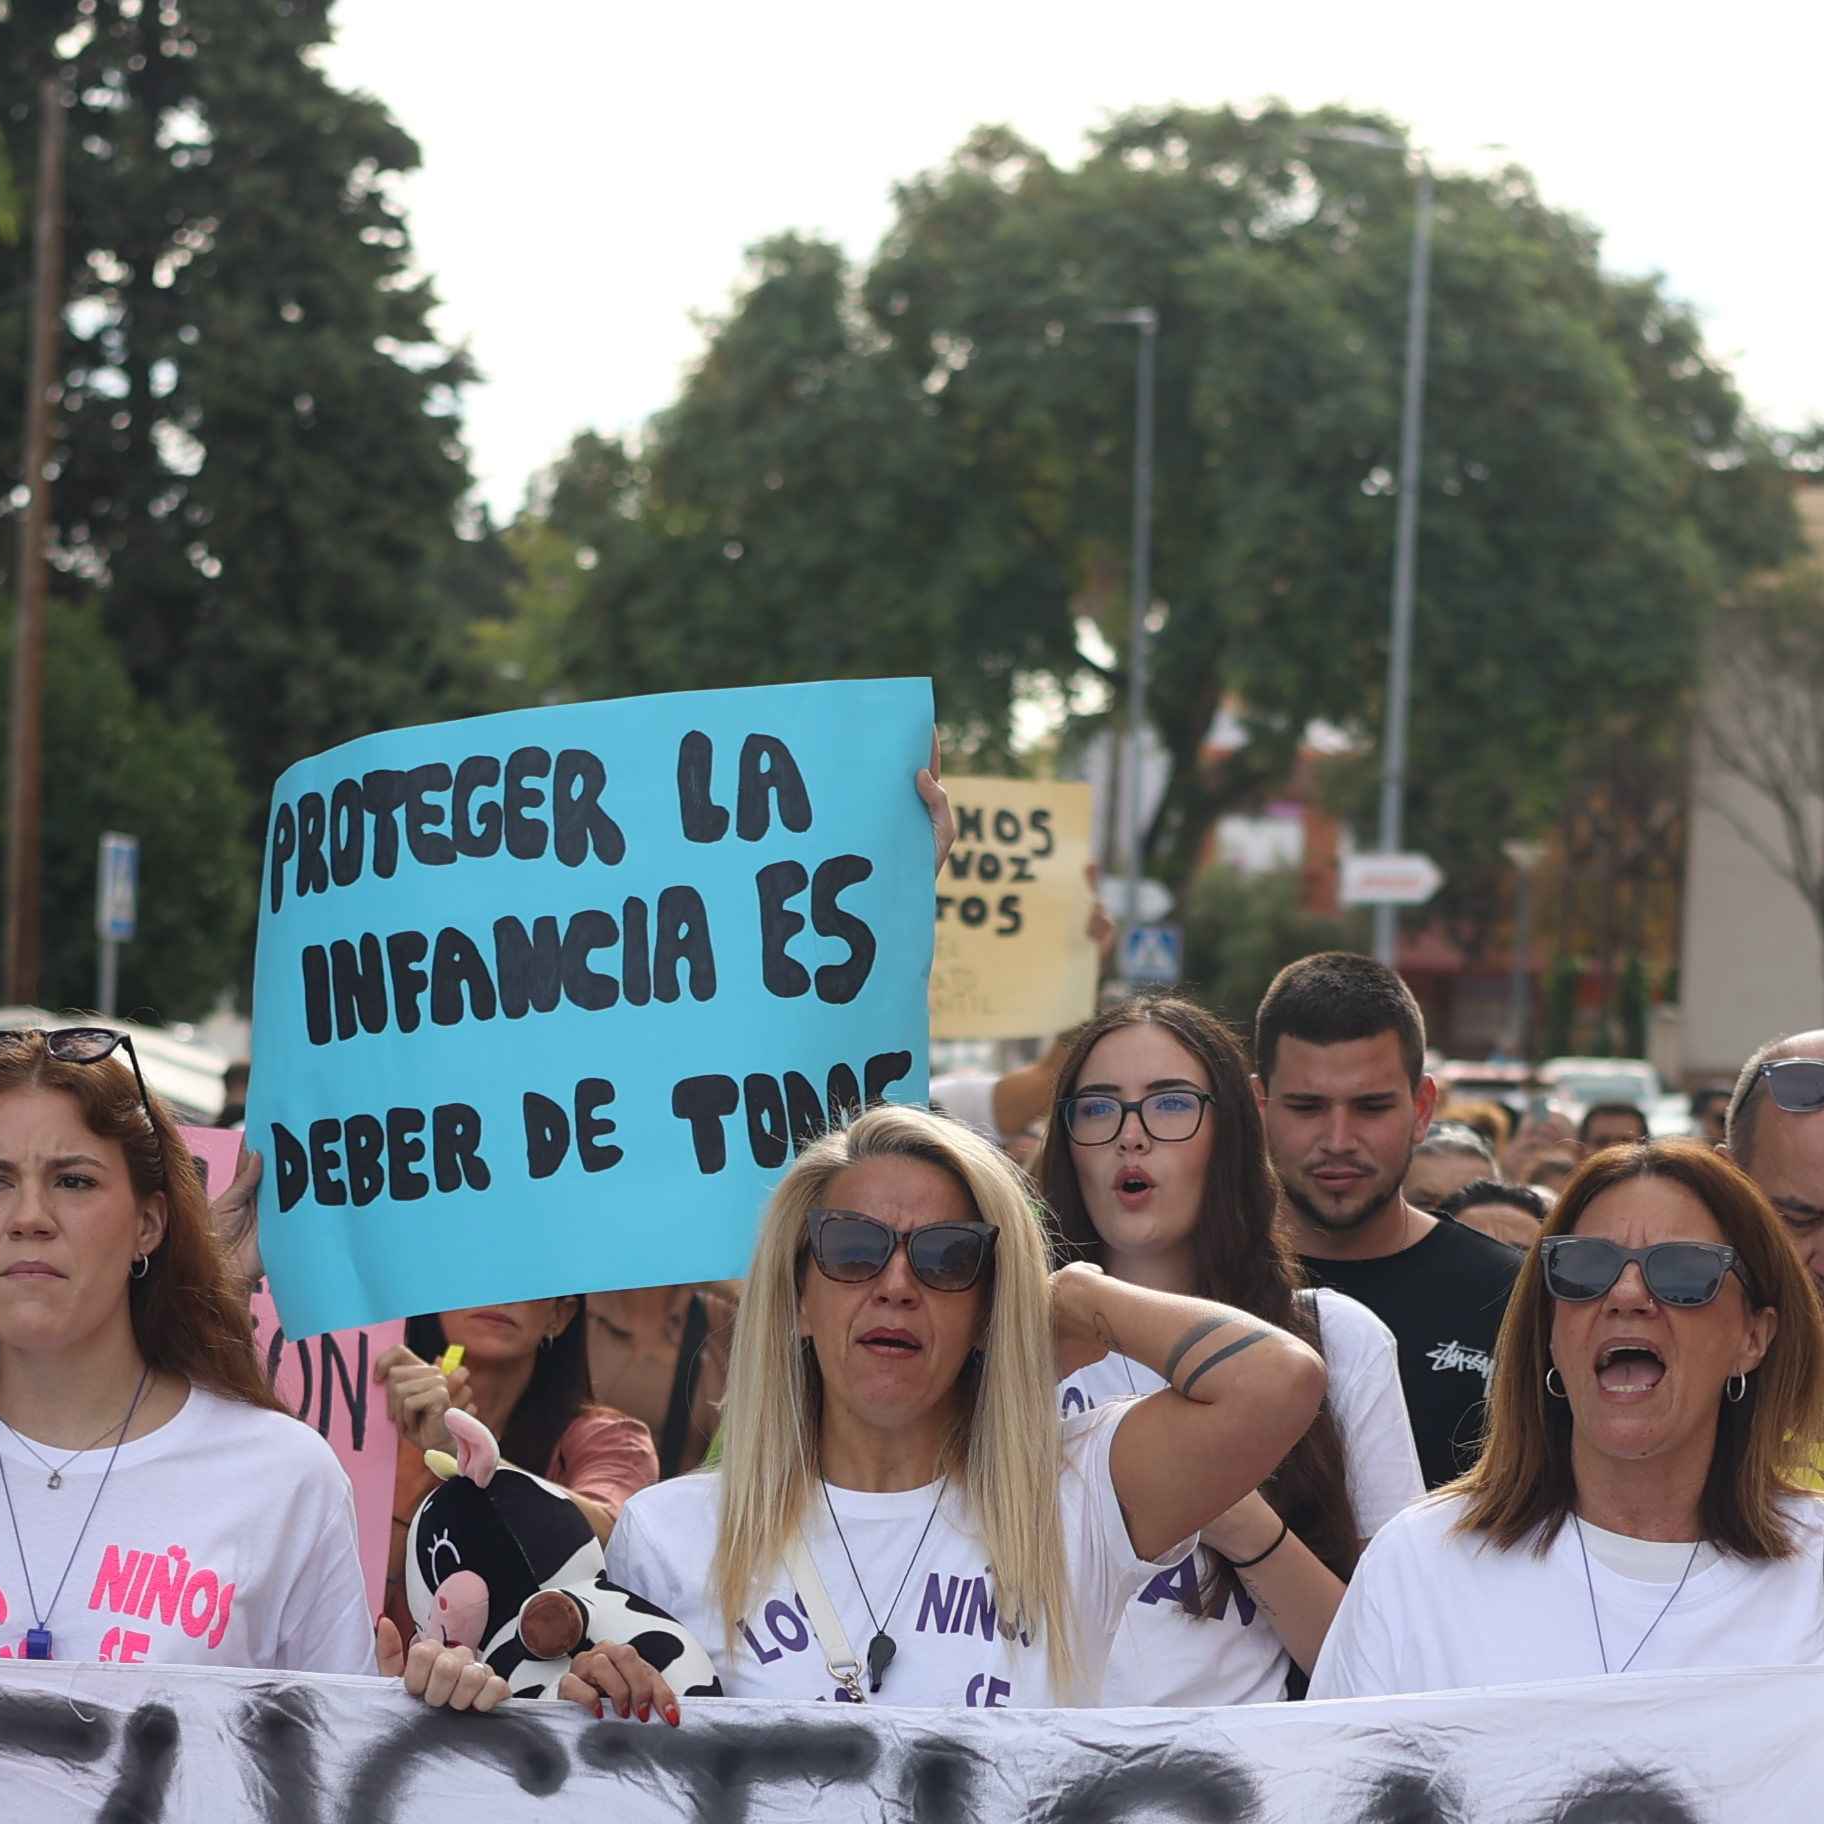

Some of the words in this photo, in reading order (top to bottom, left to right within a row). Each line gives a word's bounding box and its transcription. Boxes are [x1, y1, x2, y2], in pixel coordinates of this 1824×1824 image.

[270, 745, 626, 914] PROTEGER
[676, 729, 813, 844] LA
[301, 884, 717, 1046] INFANCIA
[754, 853, 877, 1005] ES
[270, 1102, 491, 1214] DEBER
[522, 1077, 625, 1180] DE
[87, 1544, 237, 1650] NIÑOS
